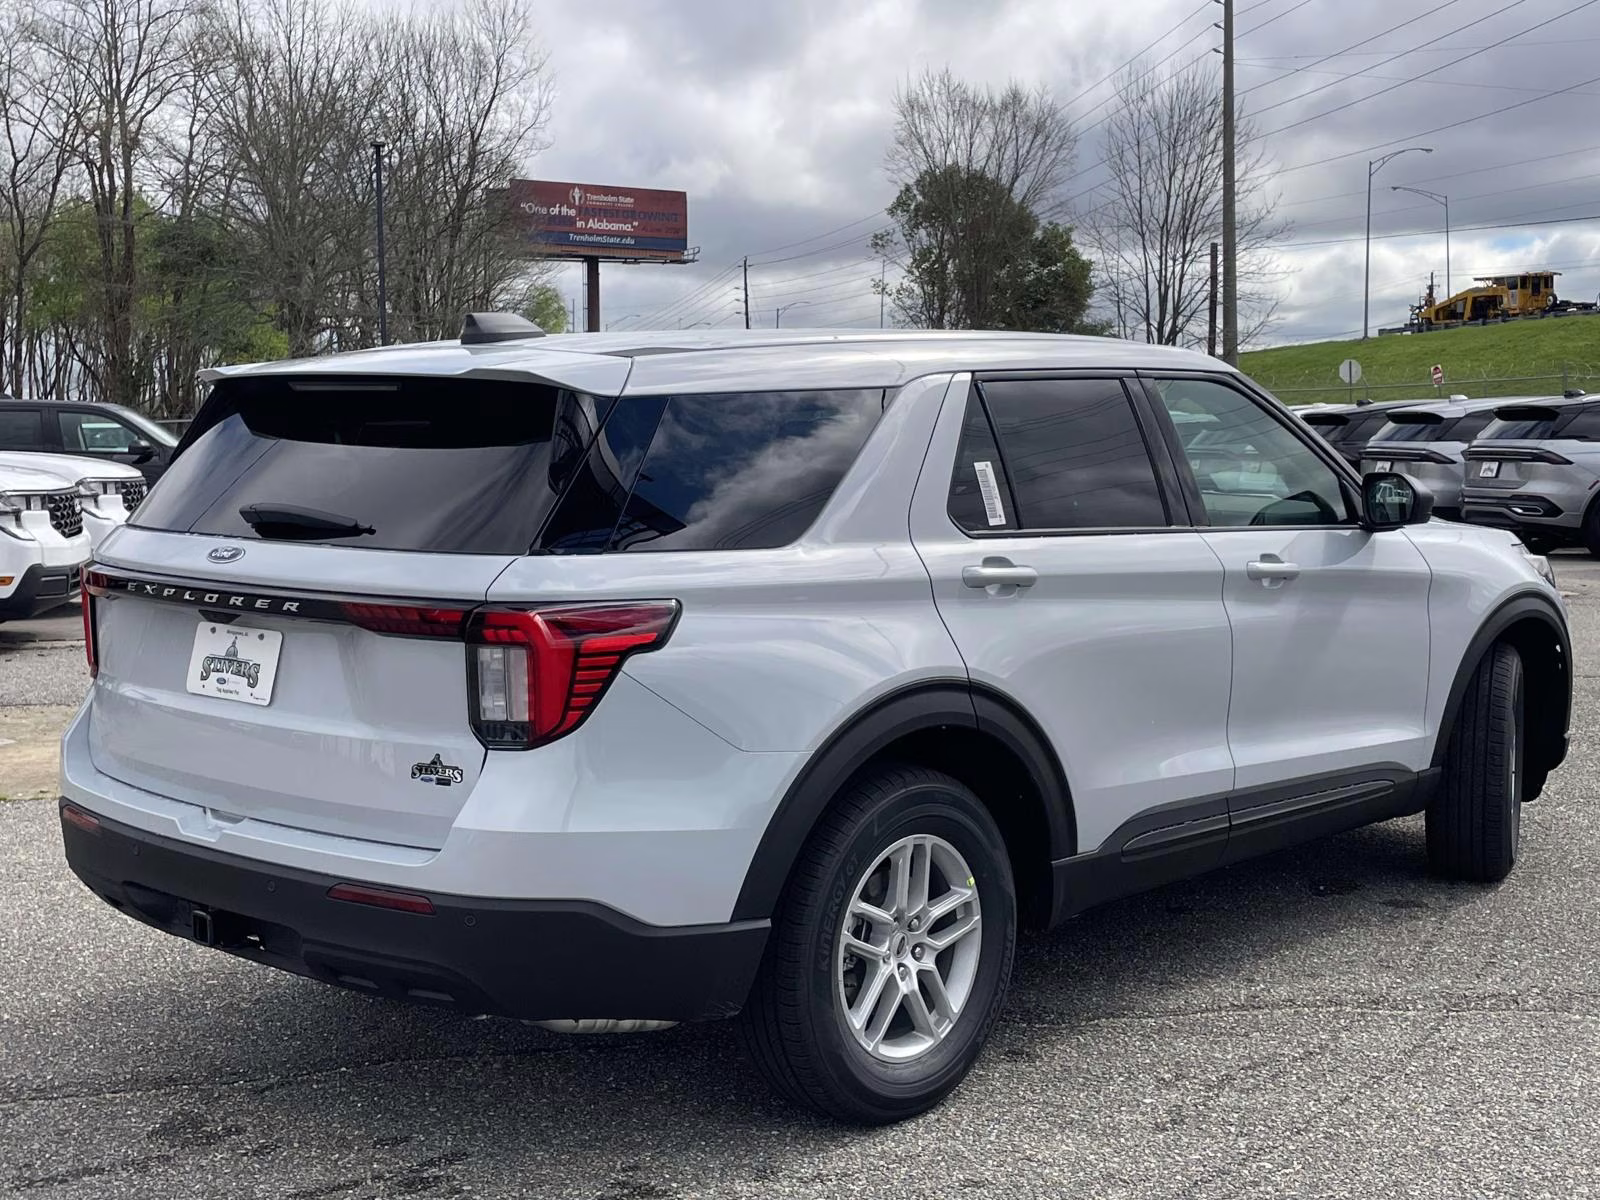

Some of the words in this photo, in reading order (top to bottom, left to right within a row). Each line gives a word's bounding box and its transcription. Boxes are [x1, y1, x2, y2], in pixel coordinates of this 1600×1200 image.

[586, 193, 618, 202] Trenholm
[549, 203, 560, 215] of
[561, 204, 576, 217] the
[576, 217, 585, 229] in
[569, 233, 636, 245] TrenholmState.edu
[127, 582, 300, 612] EXPLORER
[200, 656, 261, 689] STIVERS
[411, 764, 463, 783] STIVERS
